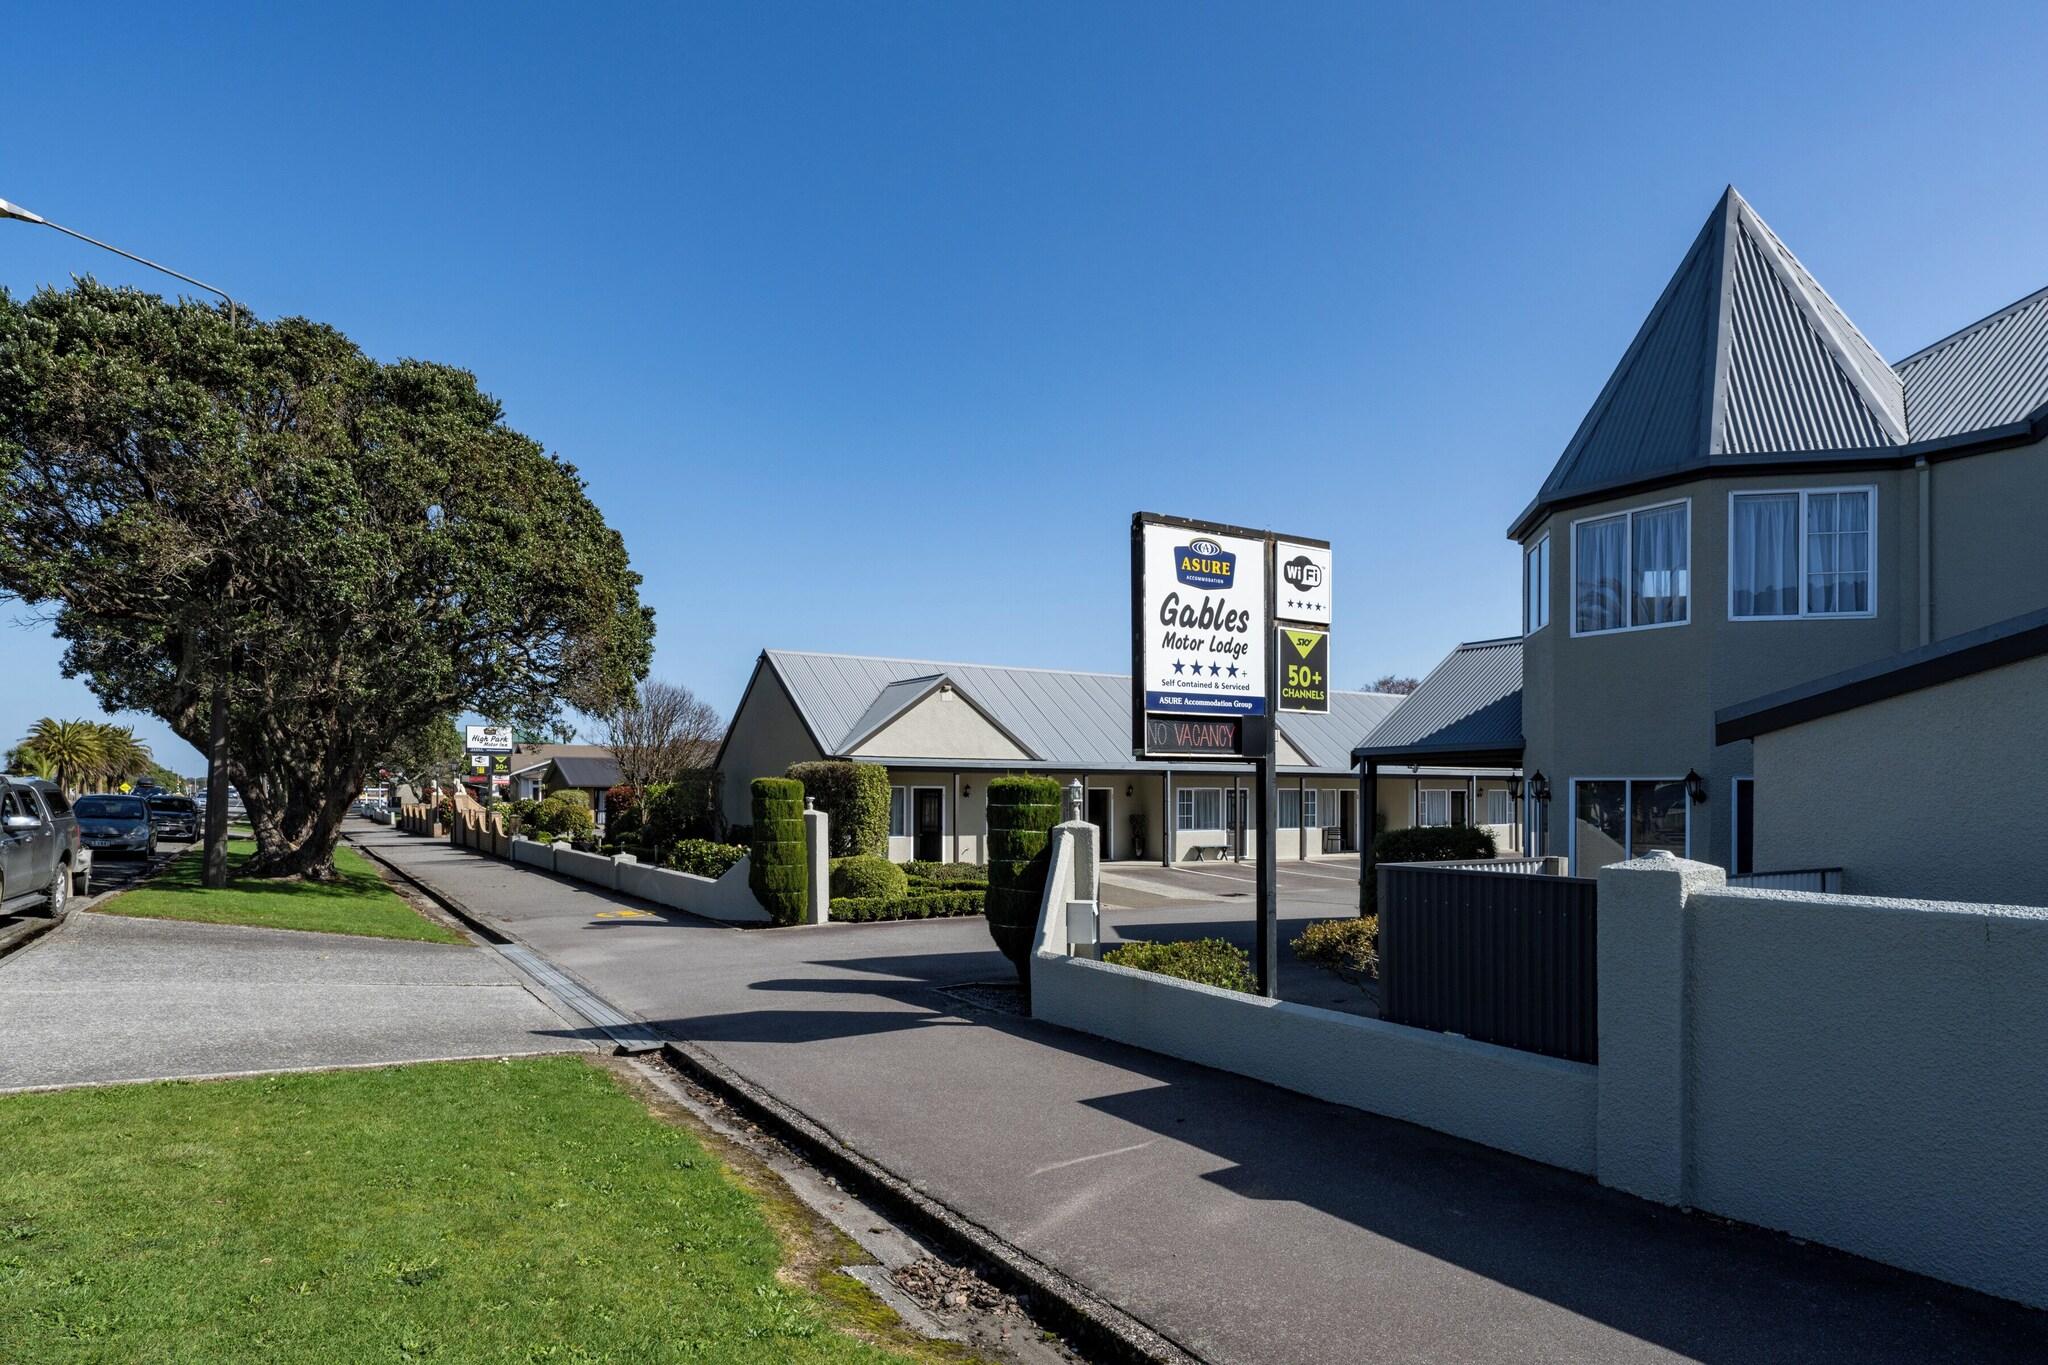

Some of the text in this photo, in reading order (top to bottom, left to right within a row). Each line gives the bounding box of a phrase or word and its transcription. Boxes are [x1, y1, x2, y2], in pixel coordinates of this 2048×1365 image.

[1181, 557, 1231, 576] ASURE
[1186, 575, 1224, 584] ACCOMMODATION
[1160, 592, 1250, 633] Gables
[1162, 631, 1248, 660] Motor Lodge
[1288, 664, 1322, 687] 50+
[1161, 679, 1250, 691] Self Contained & Serviced
[1282, 687, 1325, 700] CHANNELS
[1159, 696, 1253, 710] ASURE Accommodation Group
[472, 735, 508, 743] High Park
[1147, 722, 1236, 747] NO VACANCY
